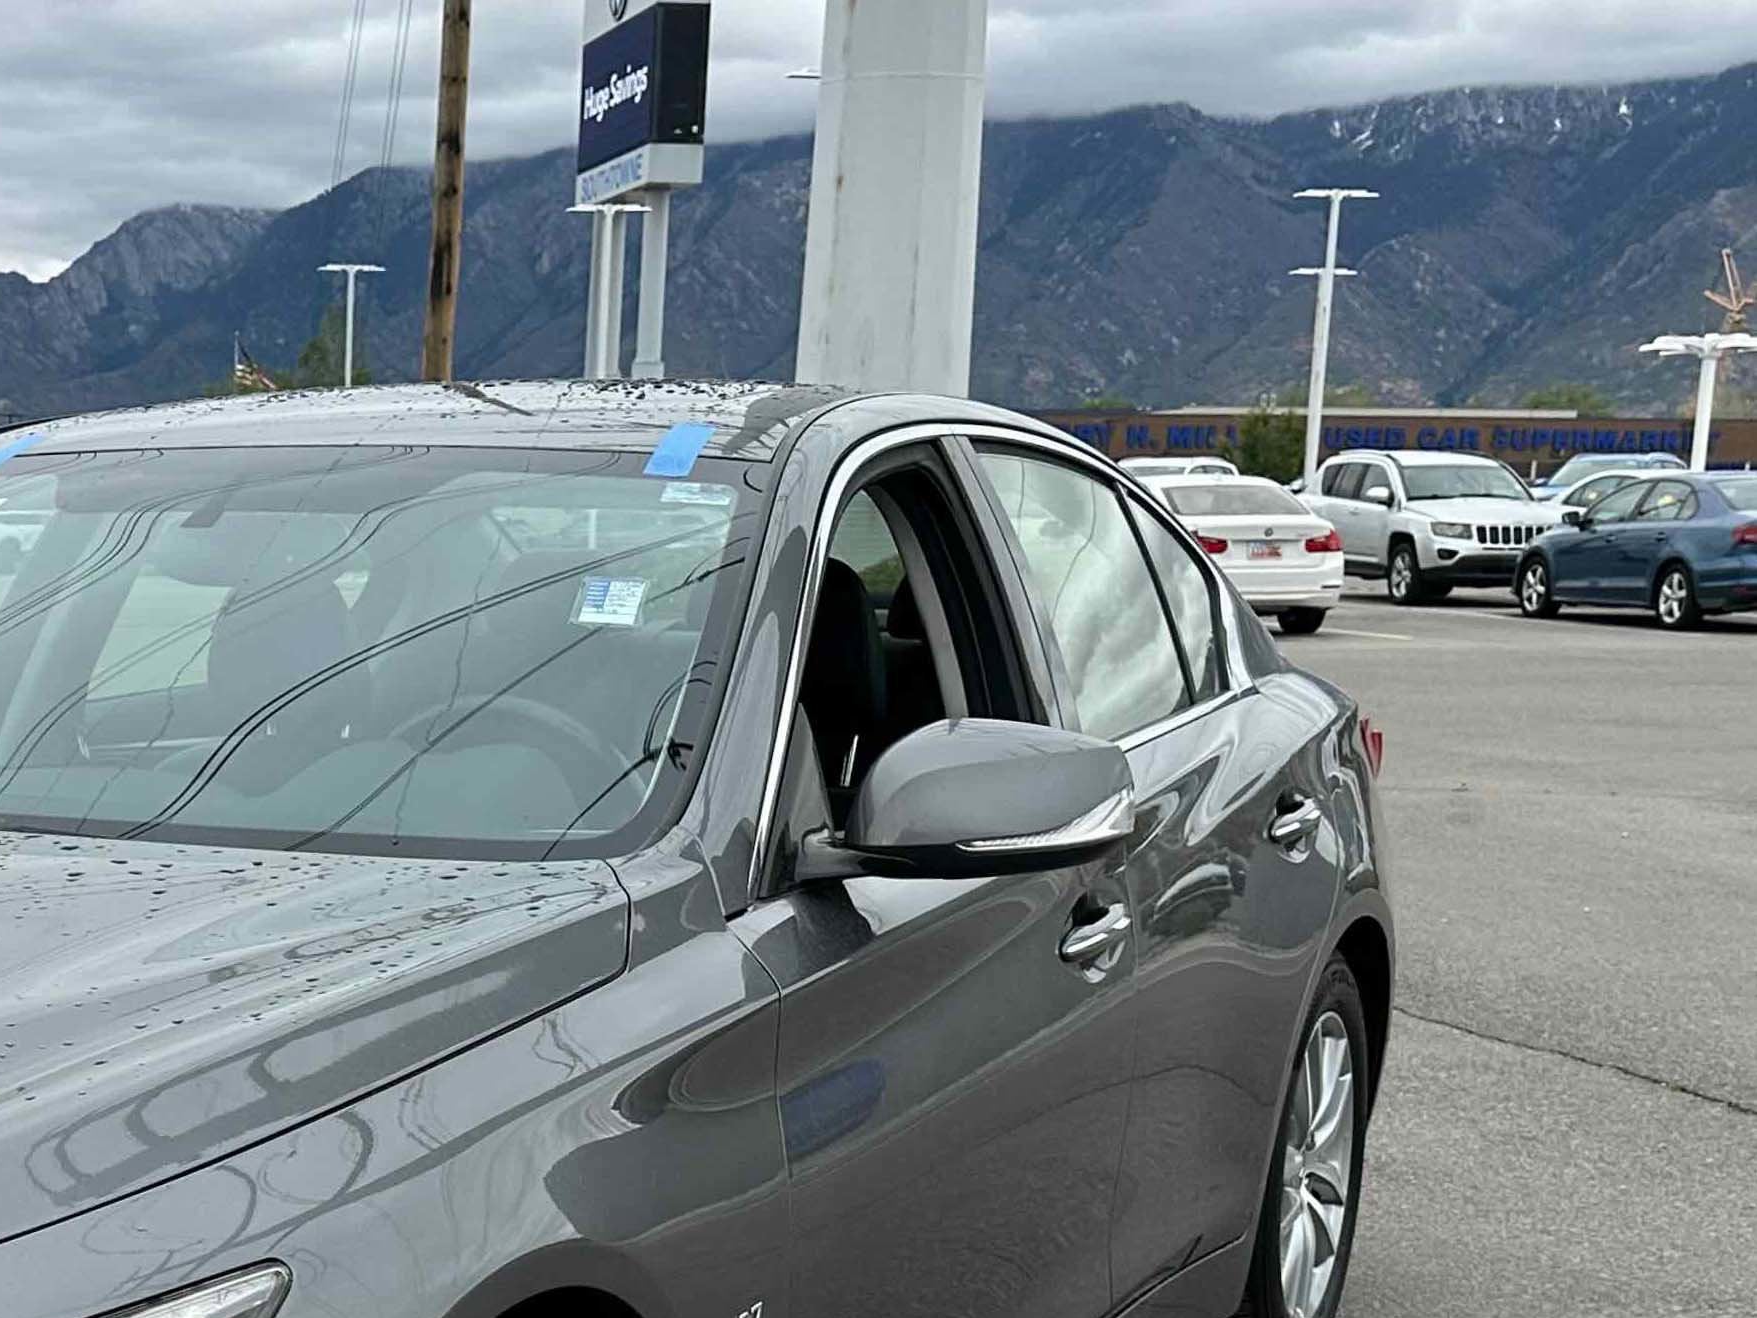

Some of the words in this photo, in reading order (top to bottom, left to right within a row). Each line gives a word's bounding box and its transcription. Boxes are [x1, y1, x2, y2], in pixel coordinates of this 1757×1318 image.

[583, 86, 610, 122] Huge
[609, 64, 648, 107] Savings
[1324, 426, 1408, 449] USED
[1418, 426, 1479, 450] CAR
